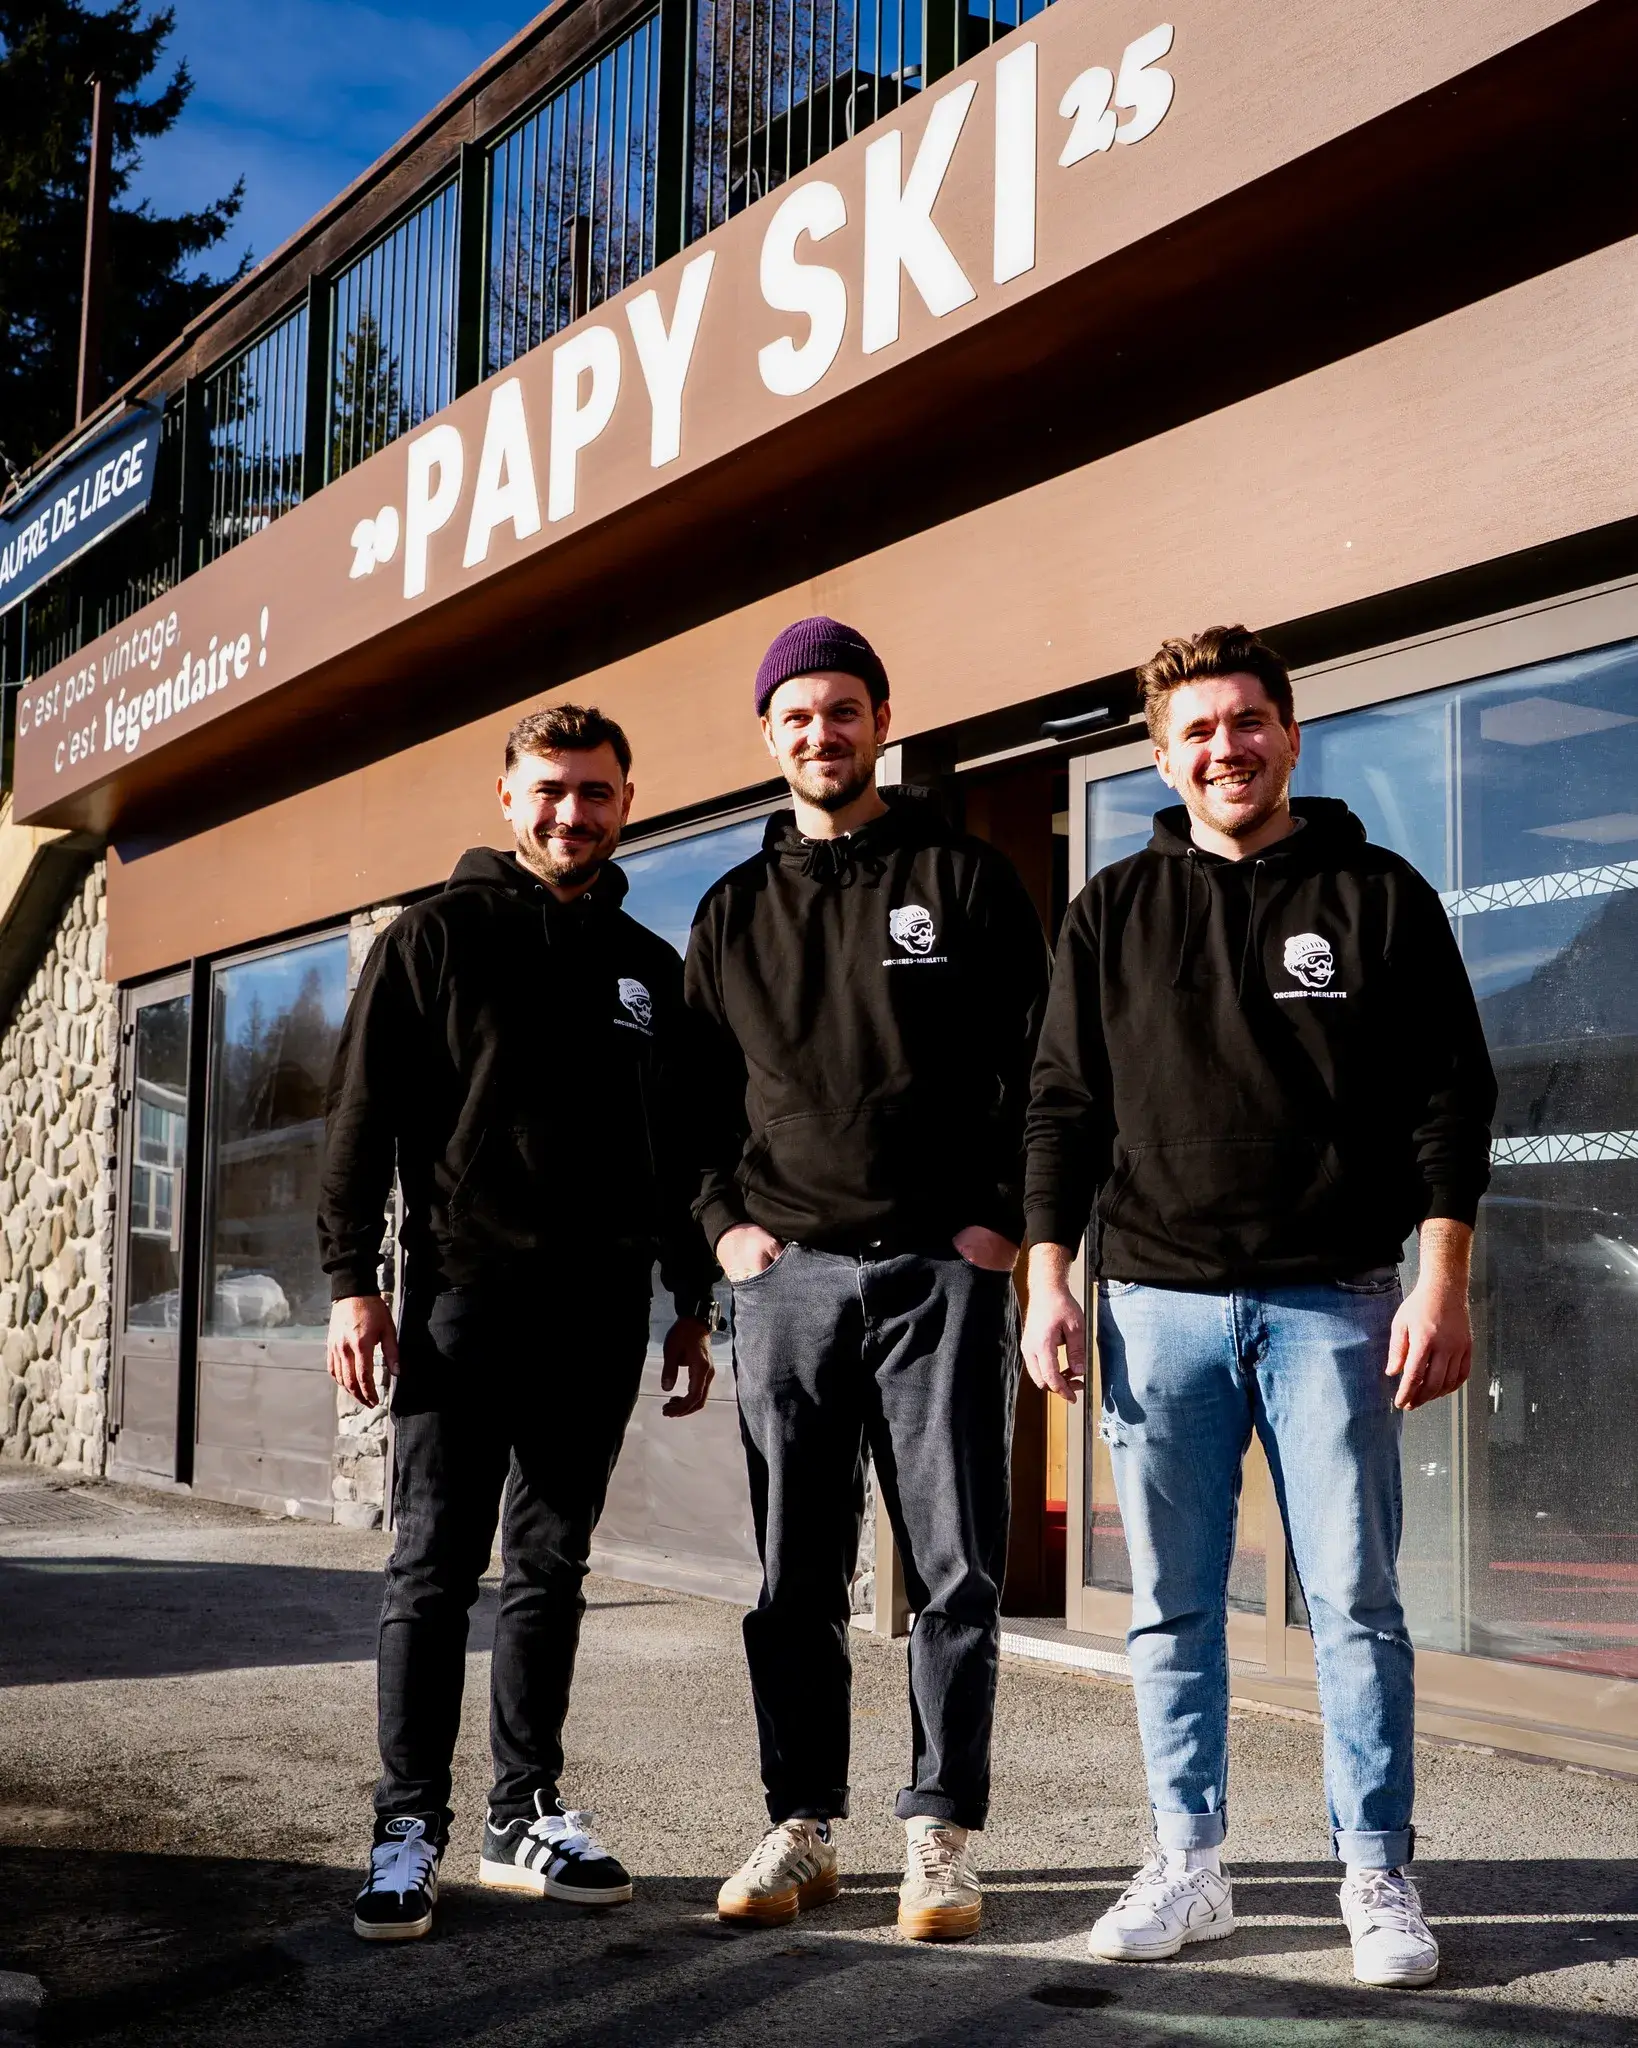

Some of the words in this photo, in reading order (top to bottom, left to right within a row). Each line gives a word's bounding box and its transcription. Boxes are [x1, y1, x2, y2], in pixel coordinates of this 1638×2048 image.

[350, 507, 400, 578] 20
[403, 250, 716, 599] PAPY
[758, 41, 1037, 396] SKI
[1059, 22, 1174, 167] 25
[0, 508, 51, 590] AUFRE
[51, 485, 80, 543] DE
[80, 438, 148, 521] LIEGE
[62, 662, 97, 723] pas
[103, 634, 251, 754] légendaire
